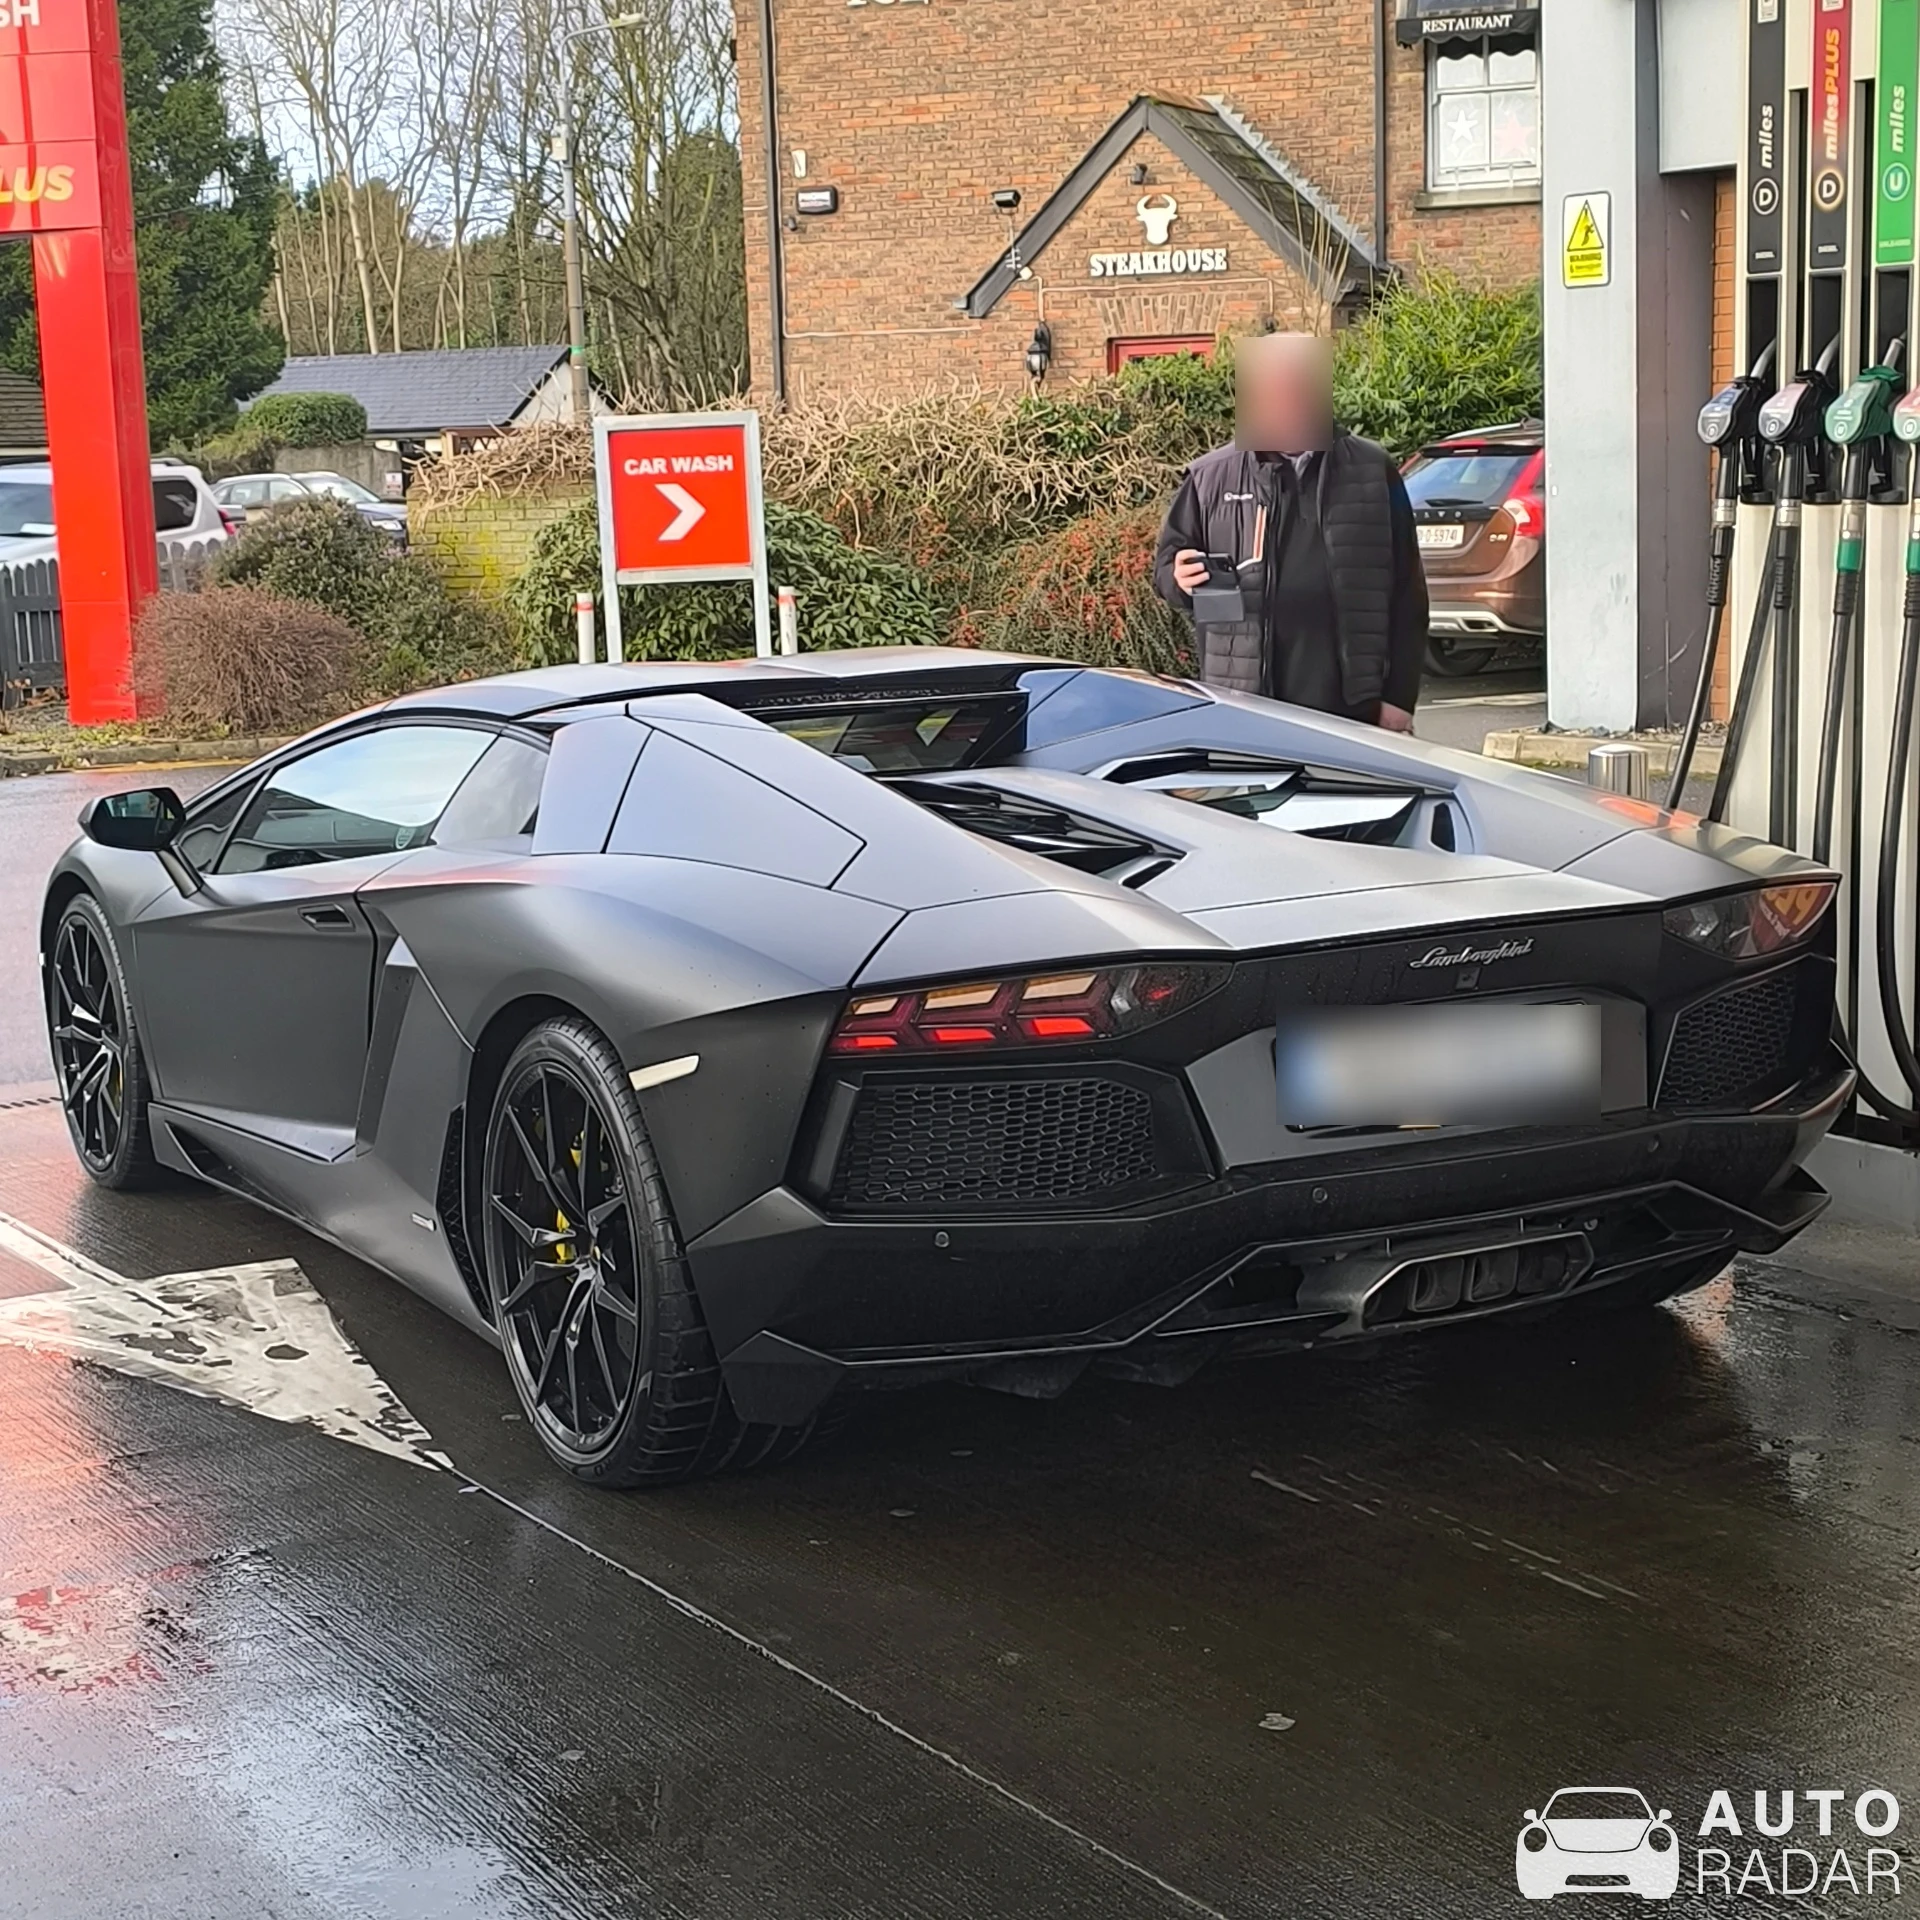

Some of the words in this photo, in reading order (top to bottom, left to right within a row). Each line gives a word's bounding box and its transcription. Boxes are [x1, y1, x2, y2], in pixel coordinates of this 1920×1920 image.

[1422, 14, 1513, 34] RESTAURANT
[1889, 85, 1905, 153] miles
[1758, 104, 1774, 169] miles
[1089, 248, 1228, 277] STEAKHOUSE
[624, 457, 667, 475] CAR
[671, 455, 734, 473] WASH
[1409, 936, 1535, 969] Lamborghini
